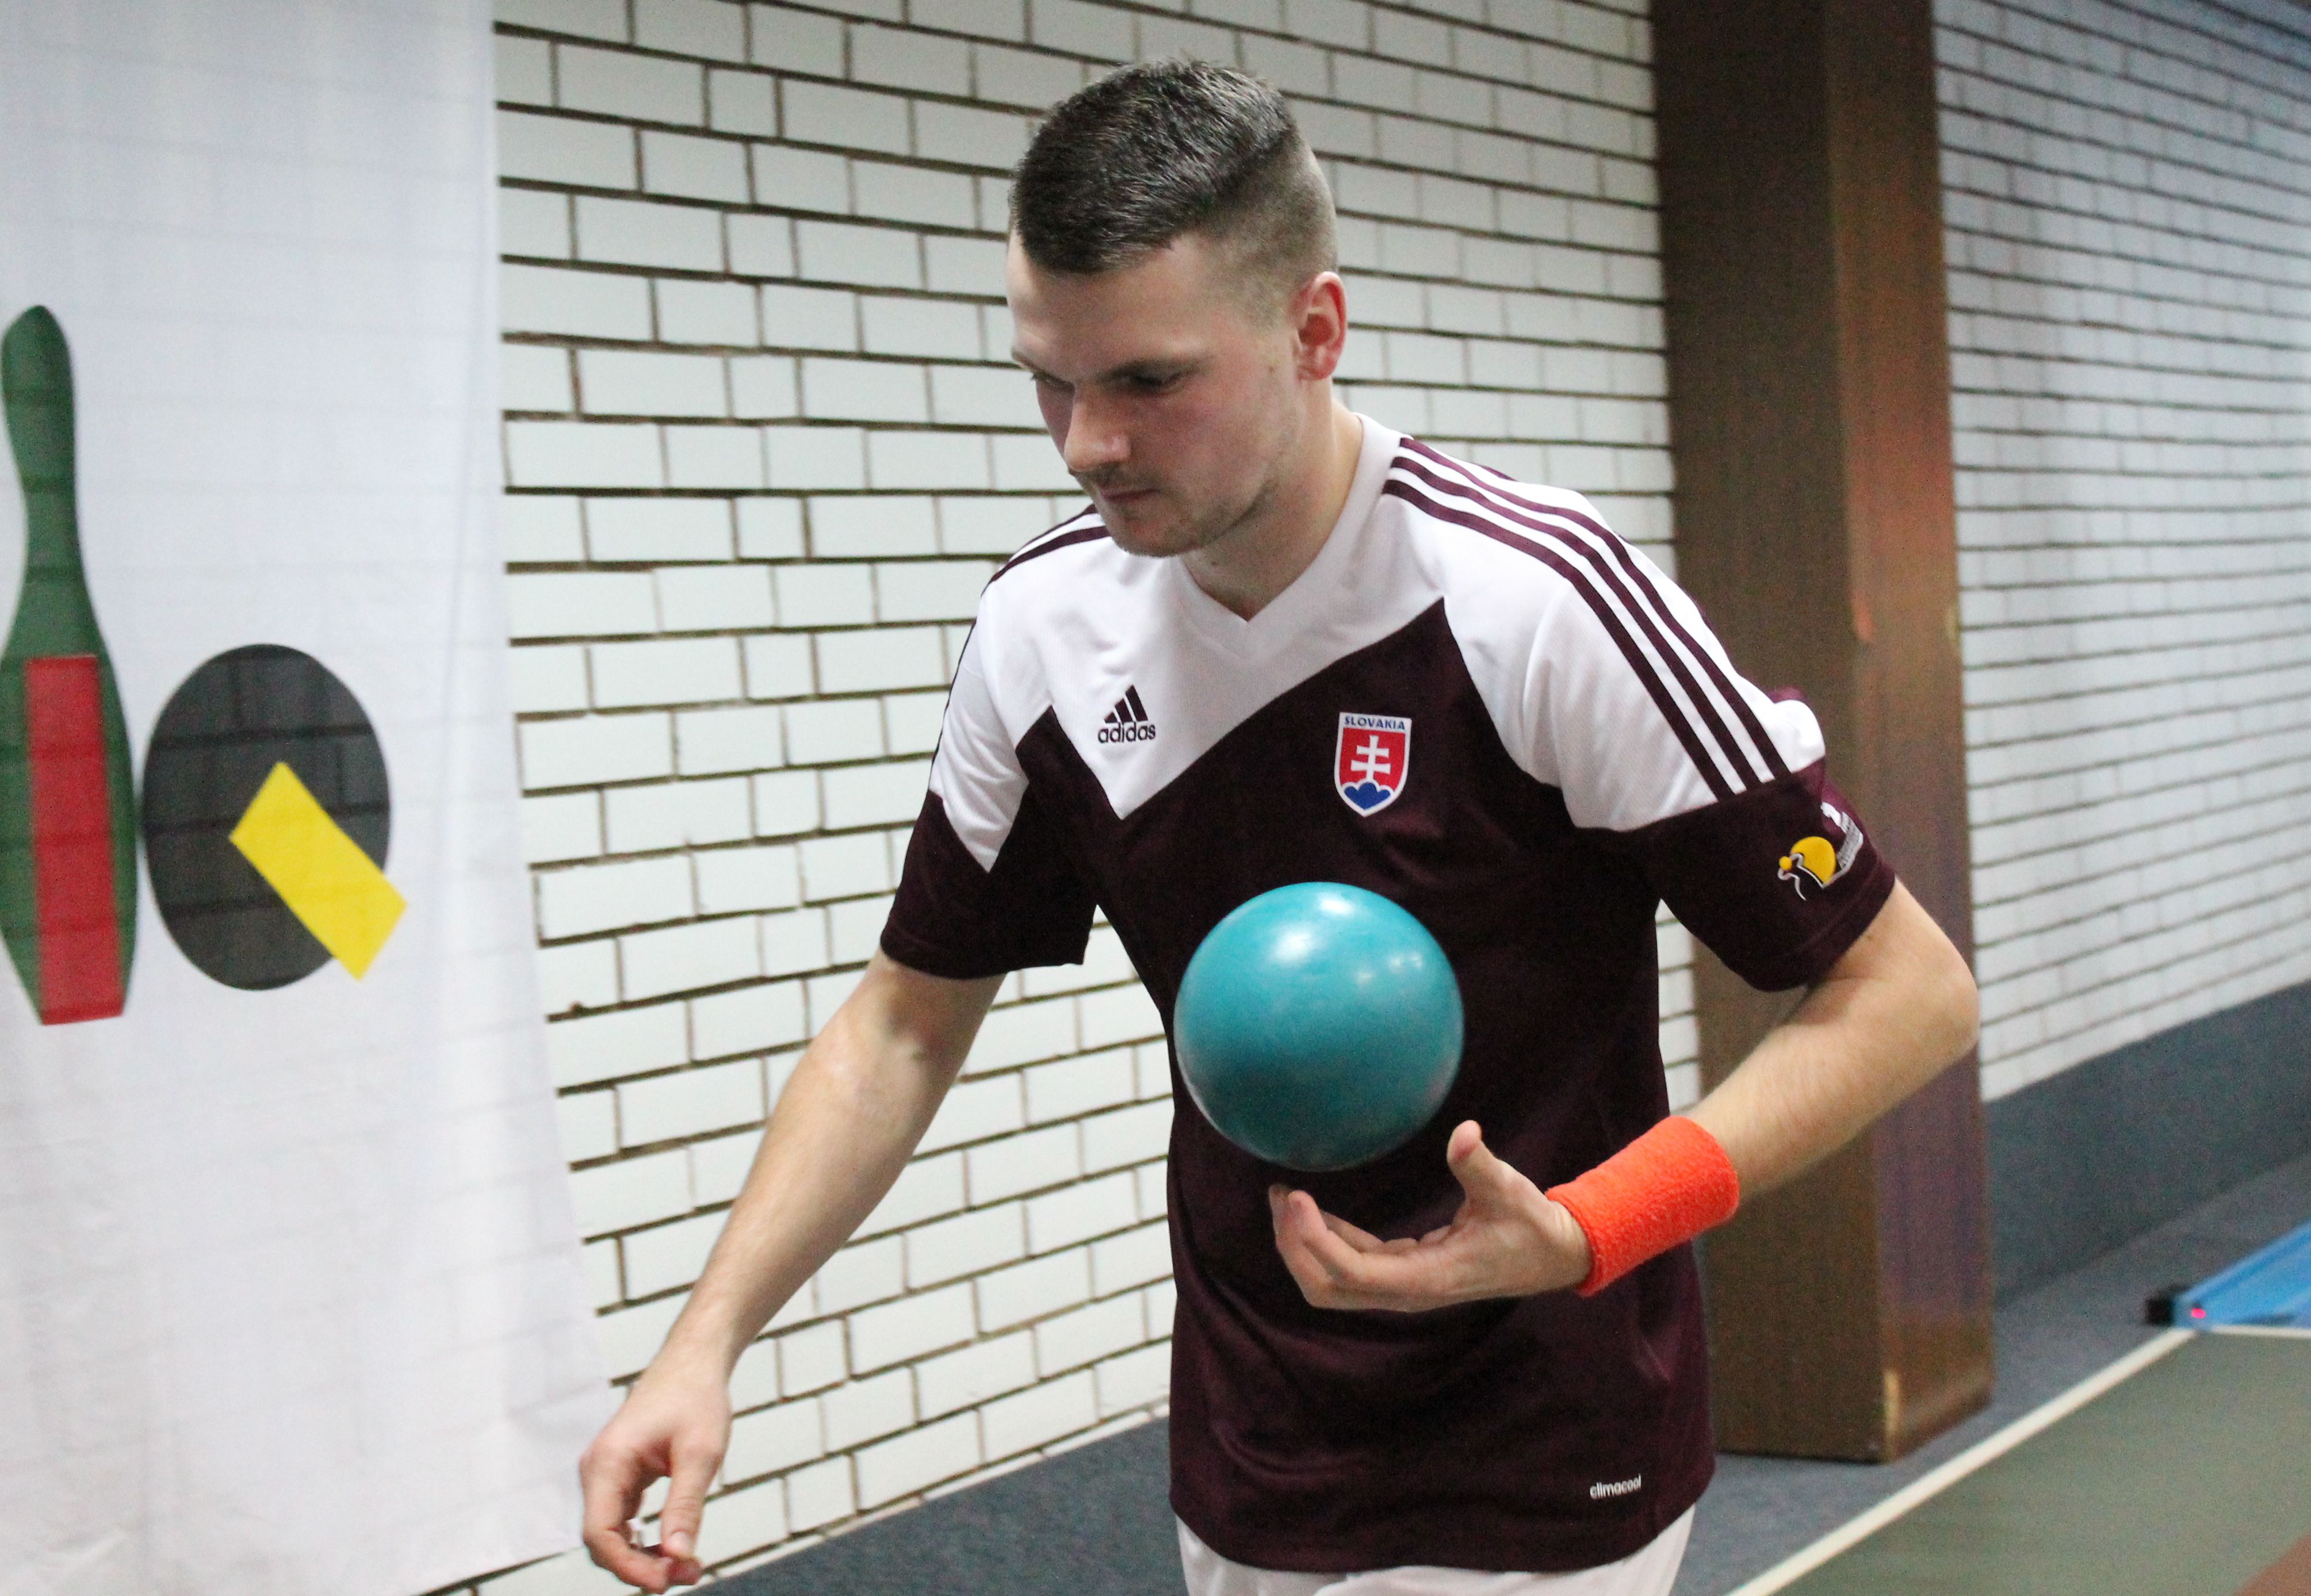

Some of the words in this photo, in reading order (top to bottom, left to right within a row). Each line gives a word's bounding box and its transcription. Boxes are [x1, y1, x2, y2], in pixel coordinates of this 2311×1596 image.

[1098, 722, 1156, 743] adidas
[1345, 715, 1405, 730] SLOVAKIA
[1590, 1473, 1642, 1499] climacool
